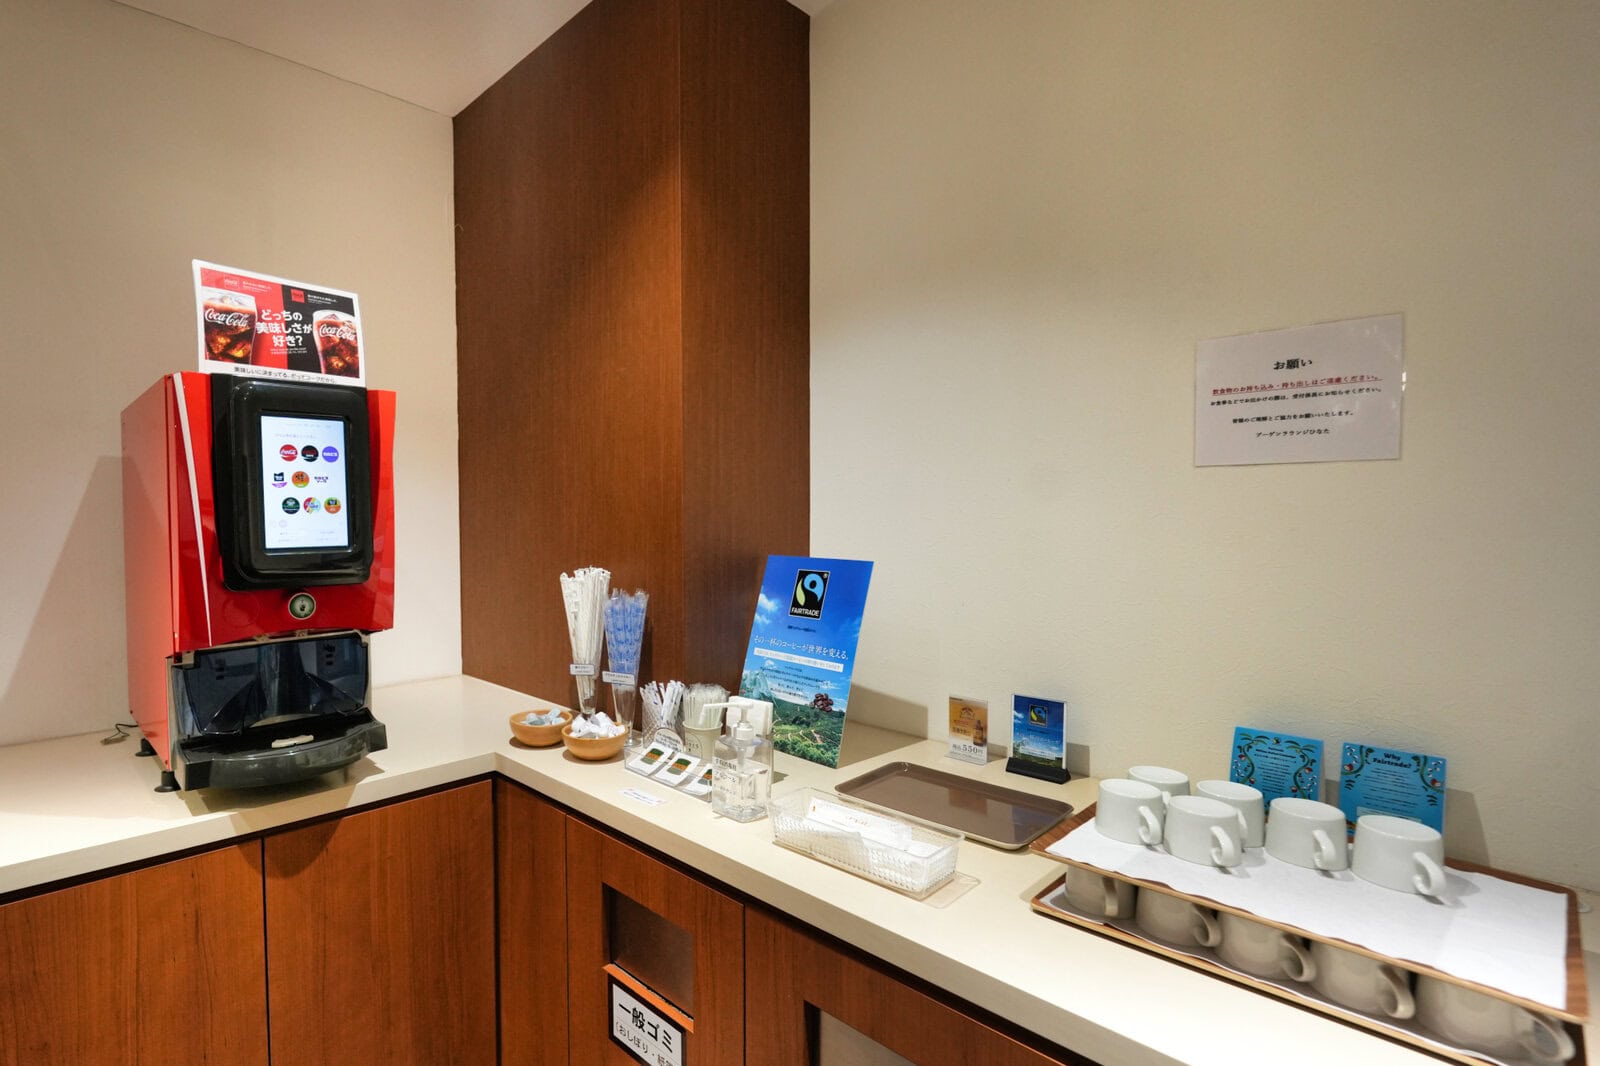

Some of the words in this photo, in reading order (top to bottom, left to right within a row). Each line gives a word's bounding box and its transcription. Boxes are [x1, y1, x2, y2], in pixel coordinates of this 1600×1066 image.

[205, 308, 249, 326] Coca-Cola
[261, 309, 303, 321] どっちの
[256, 321, 313, 334] 美味しさが
[319, 323, 356, 341] Coca-Cola
[1273, 358, 1313, 370] お願い
[791, 606, 820, 618] FAIRTRADE
[619, 1003, 673, 1053] 一般ゴミ
